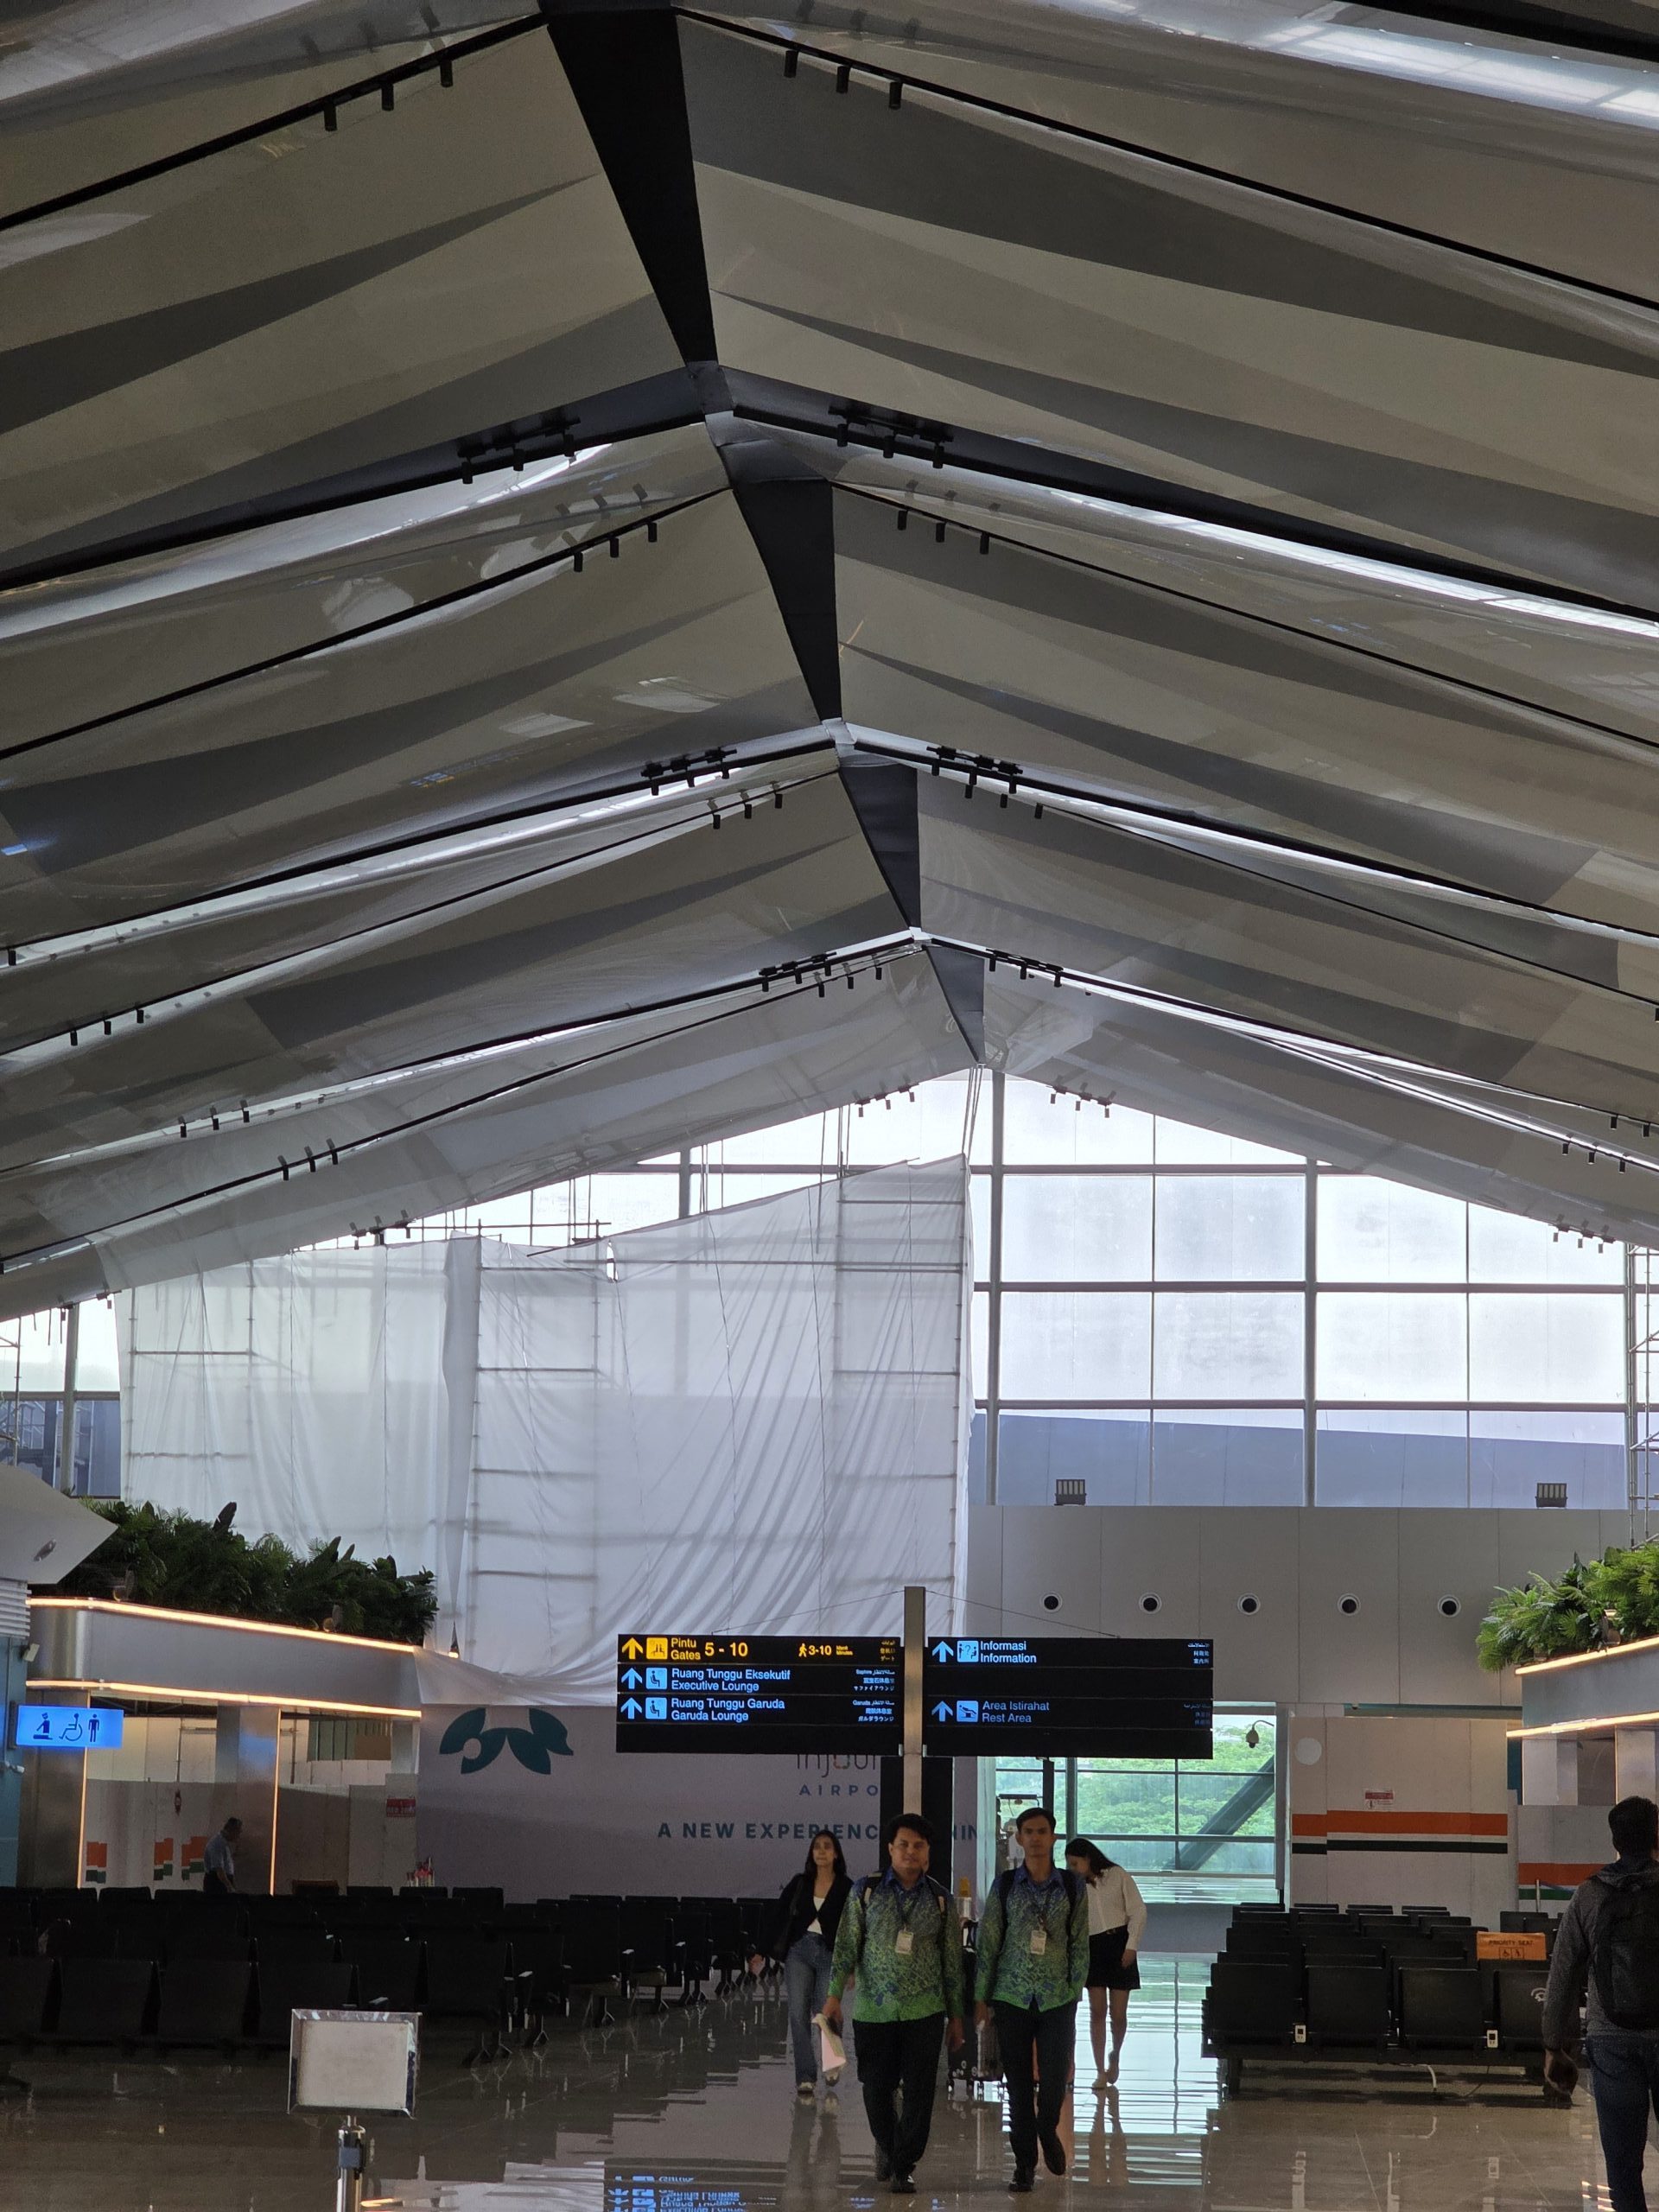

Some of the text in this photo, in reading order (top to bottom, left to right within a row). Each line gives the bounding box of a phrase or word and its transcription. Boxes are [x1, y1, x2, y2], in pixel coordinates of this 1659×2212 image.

[671, 1637, 696, 1649] Pintu
[980, 1640, 1027, 1651] Informasi
[671, 1649, 701, 1661] Gates
[704, 1642, 715, 1656] 5
[729, 1642, 748, 1657] 10
[808, 1644, 832, 1656] 3-10
[980, 1651, 1037, 1664] Information
[671, 1669, 791, 1681] Ruang Tunggu Eksekutif
[671, 1680, 760, 1693] Executive Lounge
[671, 1698, 785, 1712] Ruang Tunggu Garuda
[982, 1700, 1050, 1712] Area Istirahat
[671, 1710, 749, 1724] Garuda Lounge
[982, 1713, 1032, 1724] Rest Area
[658, 1822, 671, 1839] A
[683, 1822, 734, 1839] NEW
